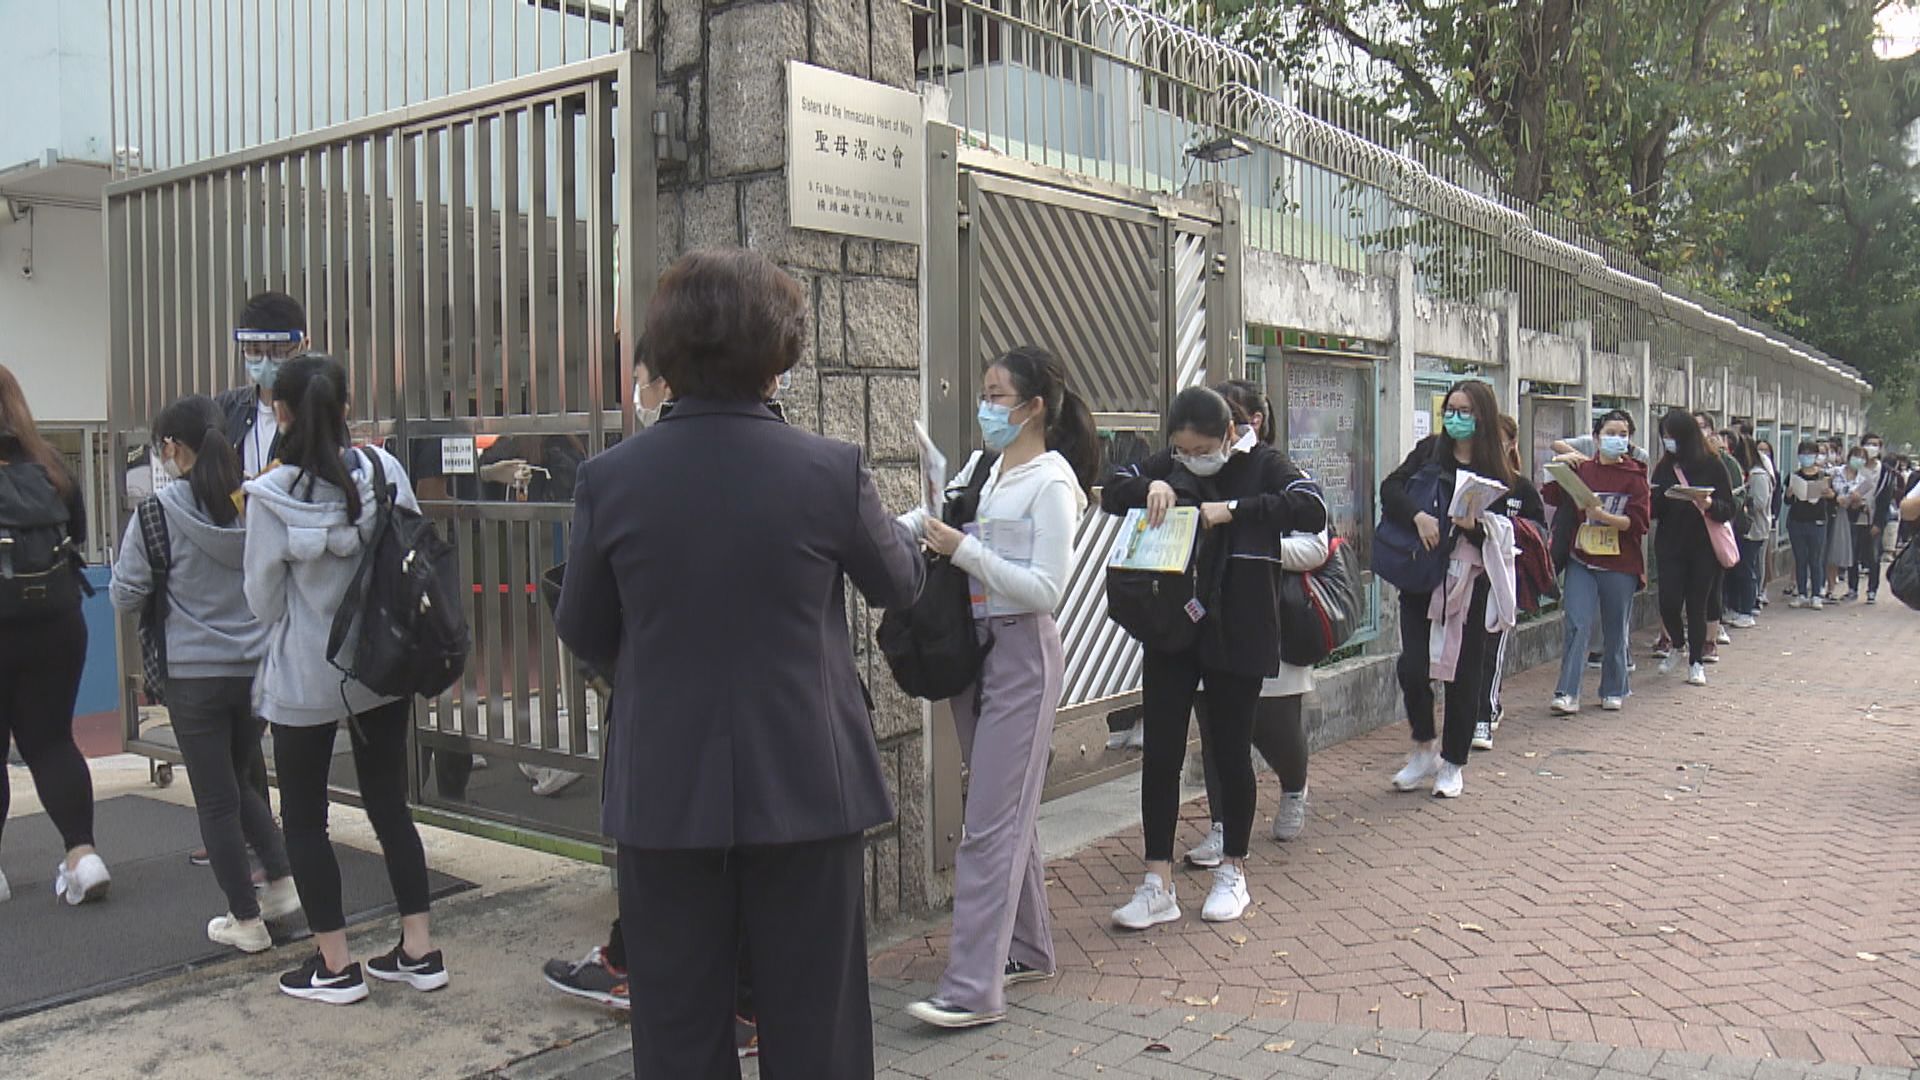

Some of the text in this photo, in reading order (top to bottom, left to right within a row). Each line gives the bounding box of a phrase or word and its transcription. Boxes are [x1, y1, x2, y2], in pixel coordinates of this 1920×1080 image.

[801, 96, 913, 139] Sisters of the Immaculate Heart of Mary
[815, 130, 904, 168] 聖母潔心會
[815, 181, 823, 193] Fu
